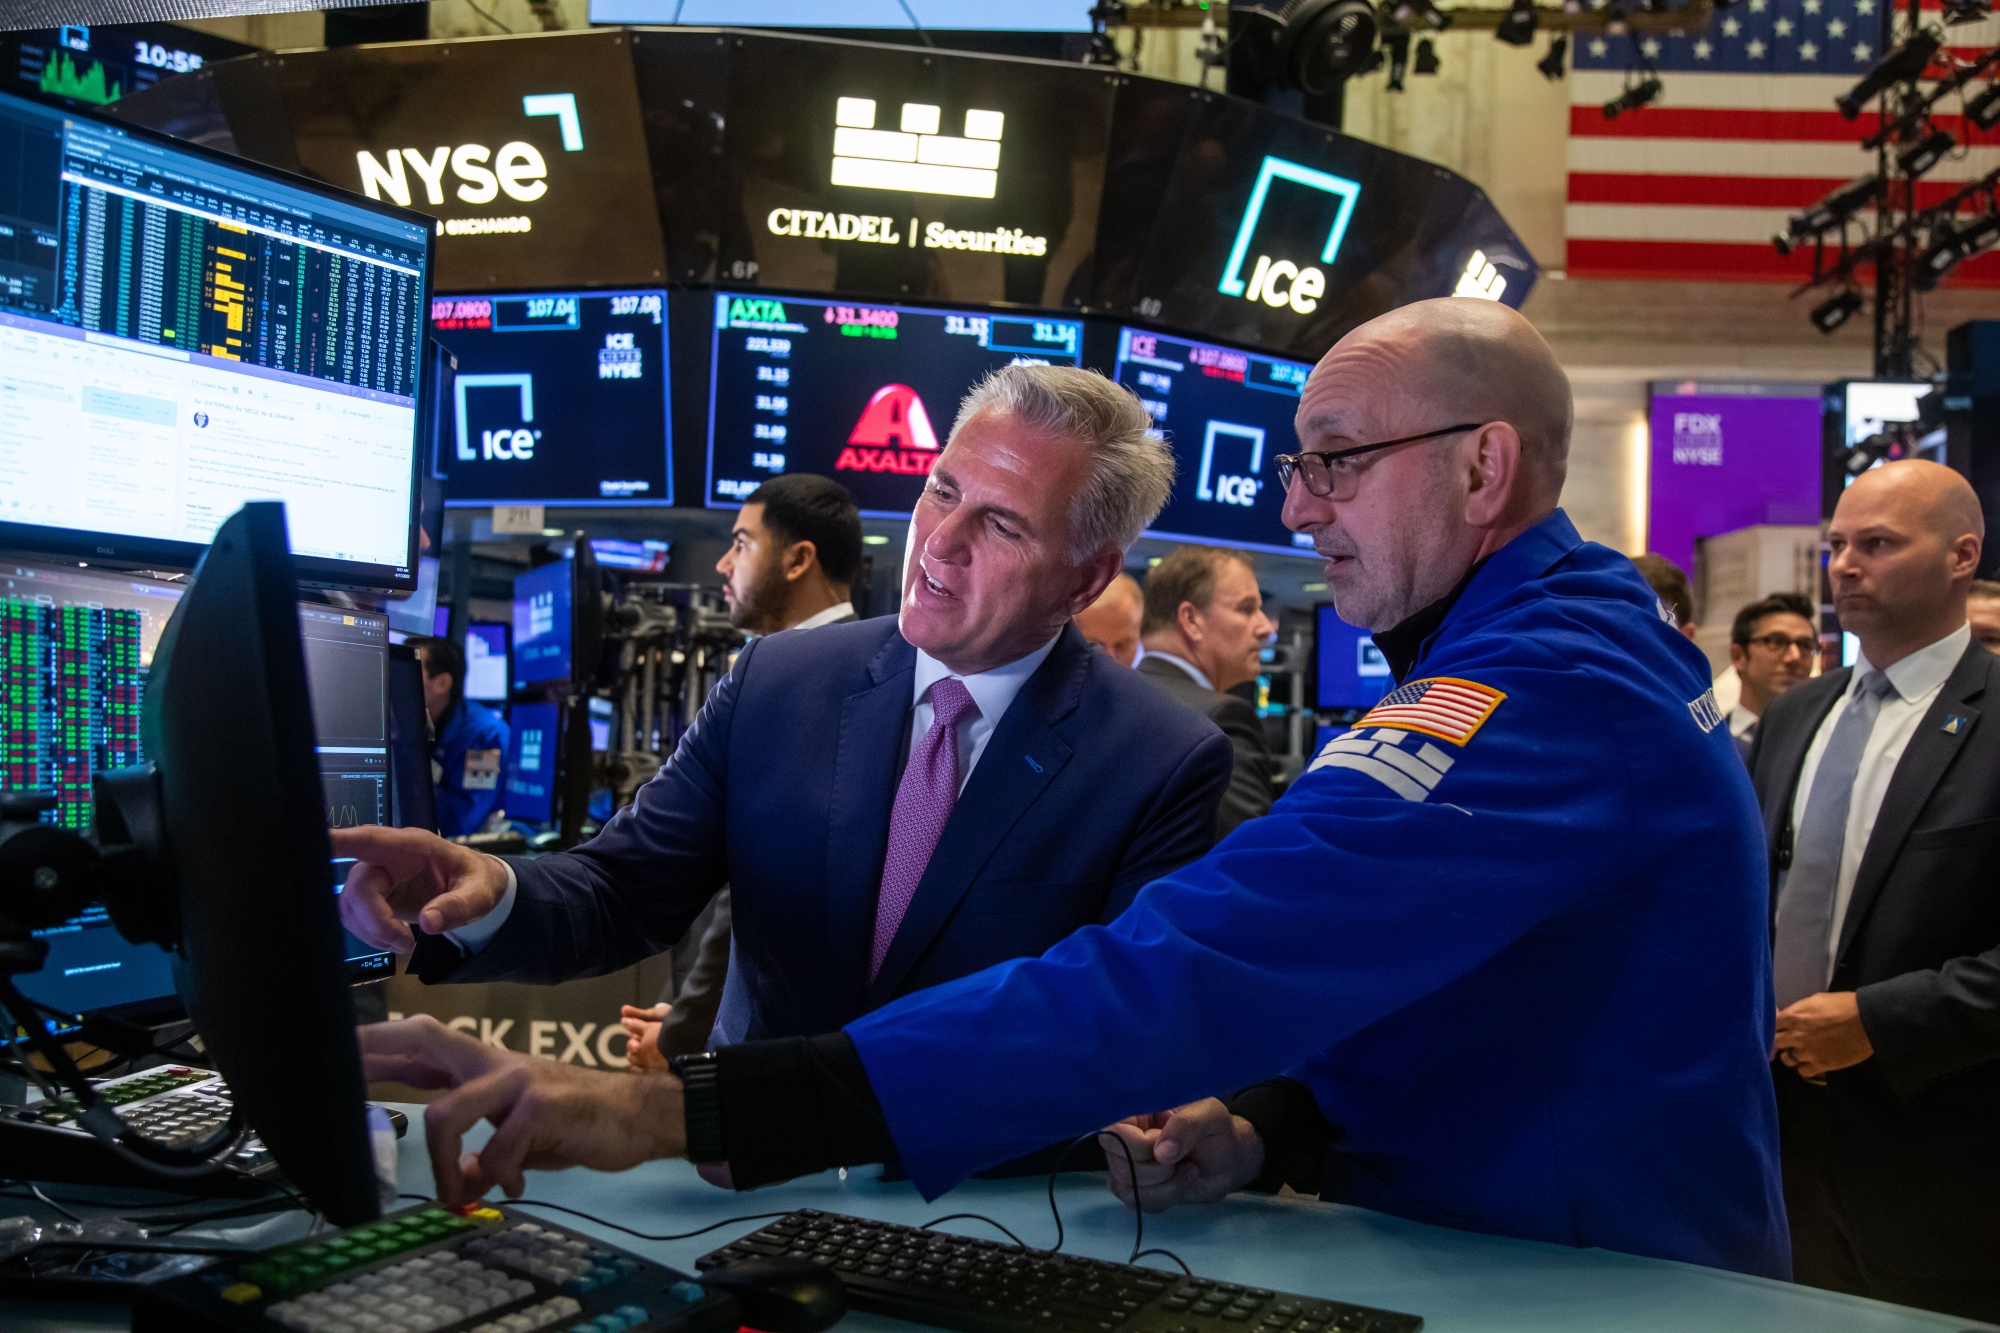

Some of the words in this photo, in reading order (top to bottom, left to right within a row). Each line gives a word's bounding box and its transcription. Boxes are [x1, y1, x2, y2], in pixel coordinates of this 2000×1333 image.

[767, 207, 900, 244] CITADEL
[924, 221, 1047, 256] Securities
[729, 298, 787, 323] AXTA
[1130, 335, 1158, 358] ICE
[598, 361, 642, 379] NYSE
[1674, 412, 1722, 436] FDX
[1673, 447, 1723, 466] NYSE
